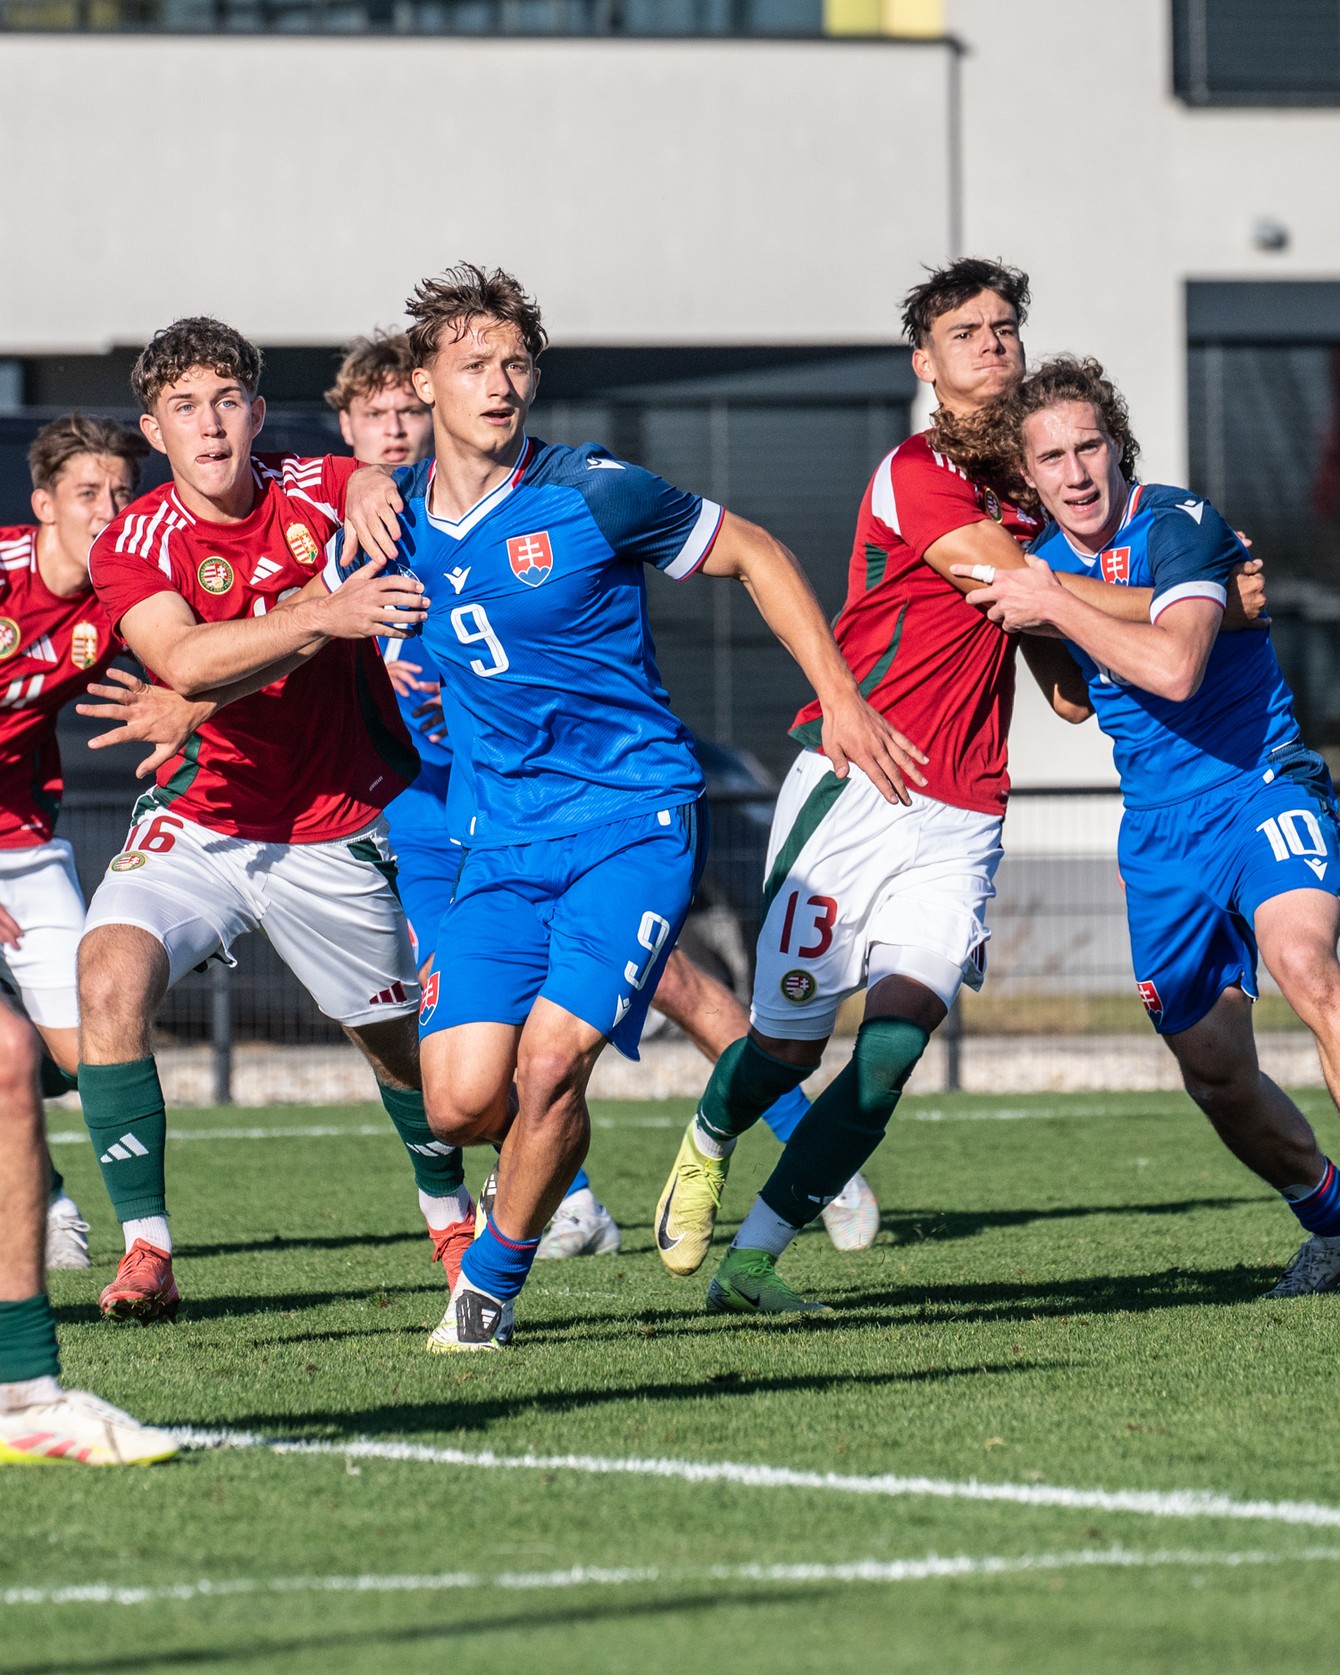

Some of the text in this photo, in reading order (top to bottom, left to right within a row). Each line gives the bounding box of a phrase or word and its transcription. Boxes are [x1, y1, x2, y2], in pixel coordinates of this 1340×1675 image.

[450, 603, 509, 677] 9
[125, 815, 184, 853] 16
[1255, 808, 1328, 862] 10
[624, 910, 670, 991] 9
[779, 890, 838, 959] 13
